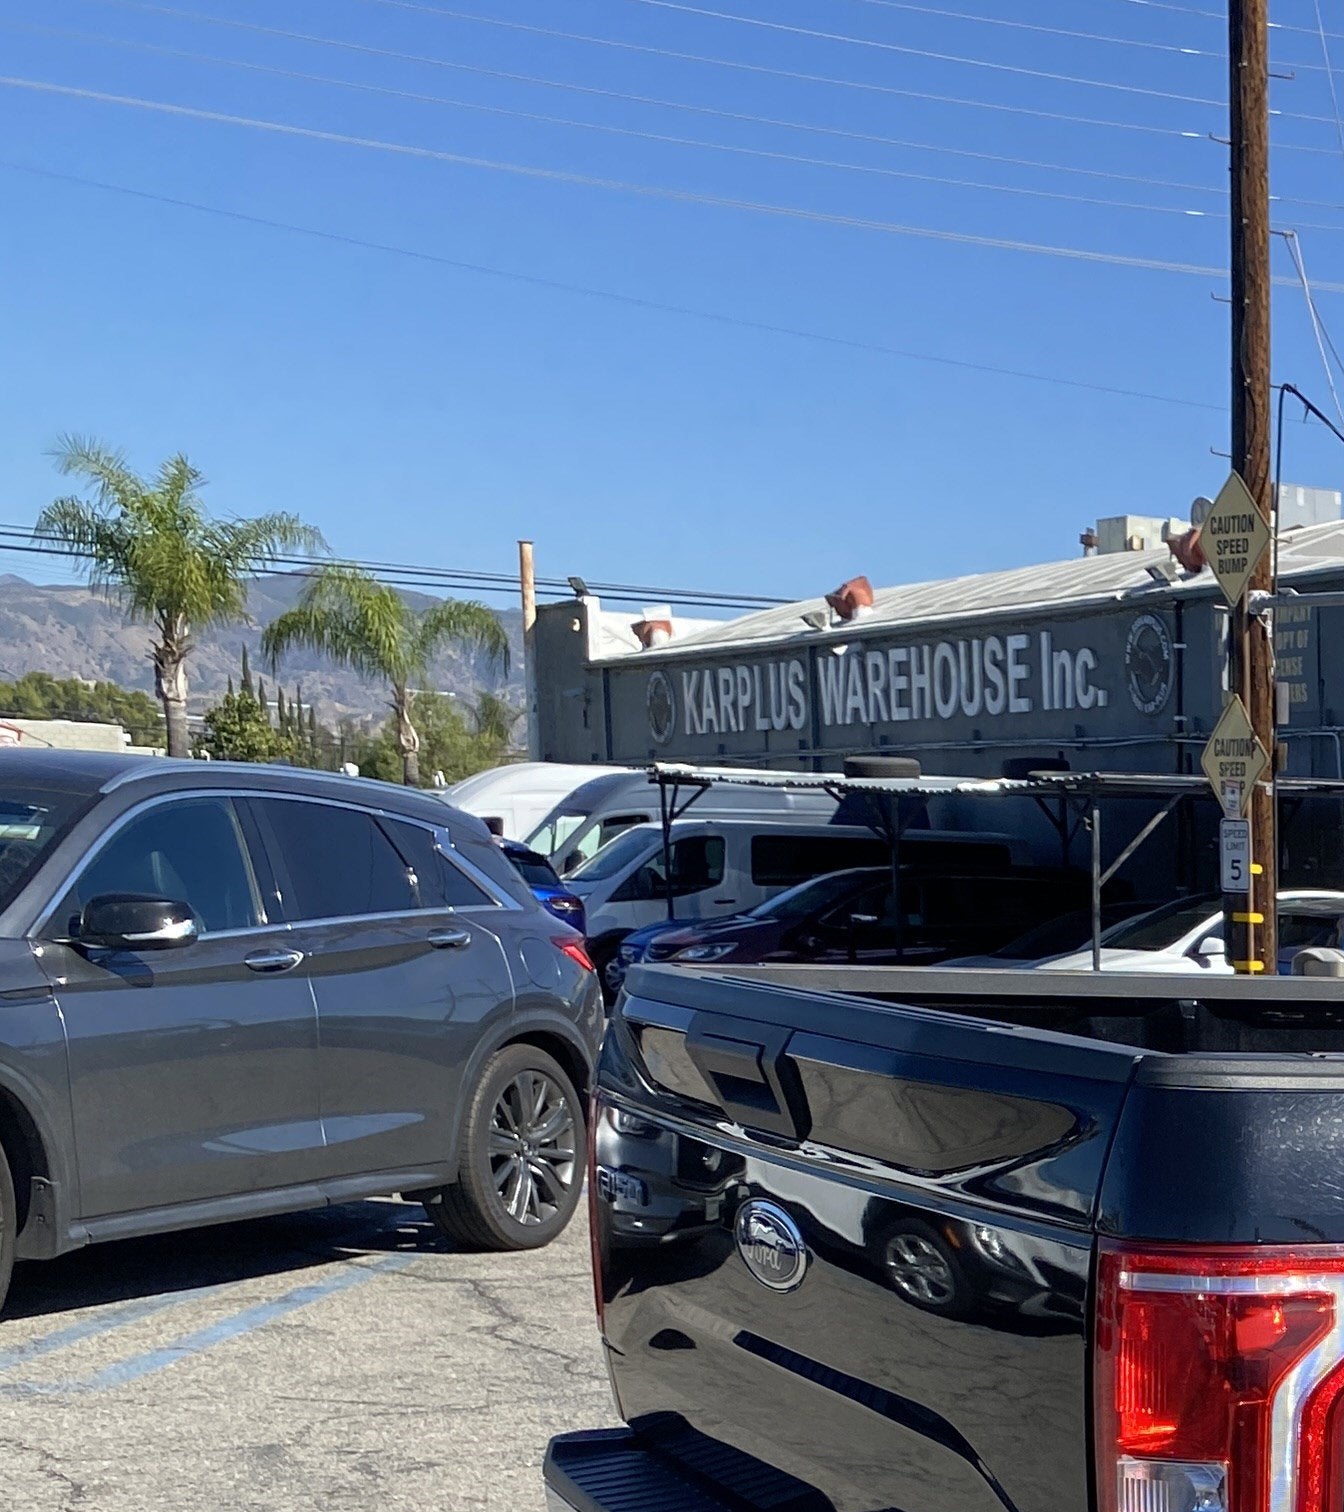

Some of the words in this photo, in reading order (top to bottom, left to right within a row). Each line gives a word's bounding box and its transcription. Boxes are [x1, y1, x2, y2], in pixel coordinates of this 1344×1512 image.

[1210, 514, 1255, 535] CAUTION
[1216, 538, 1249, 555] SPEED
[1218, 557, 1248, 574] BUMP
[682, 660, 806, 735] KARPLUS
[817, 633, 1031, 727] WAREHOUSE
[1040, 631, 1108, 711] Inc.
[1214, 738, 1253, 757] CAUTION
[1219, 762, 1246, 777] SPEED
[1220, 780, 1246, 796] BP
[1223, 828, 1248, 838] SPEED
[1225, 841, 1246, 851] LIMIT
[1230, 859, 1242, 881] 5
